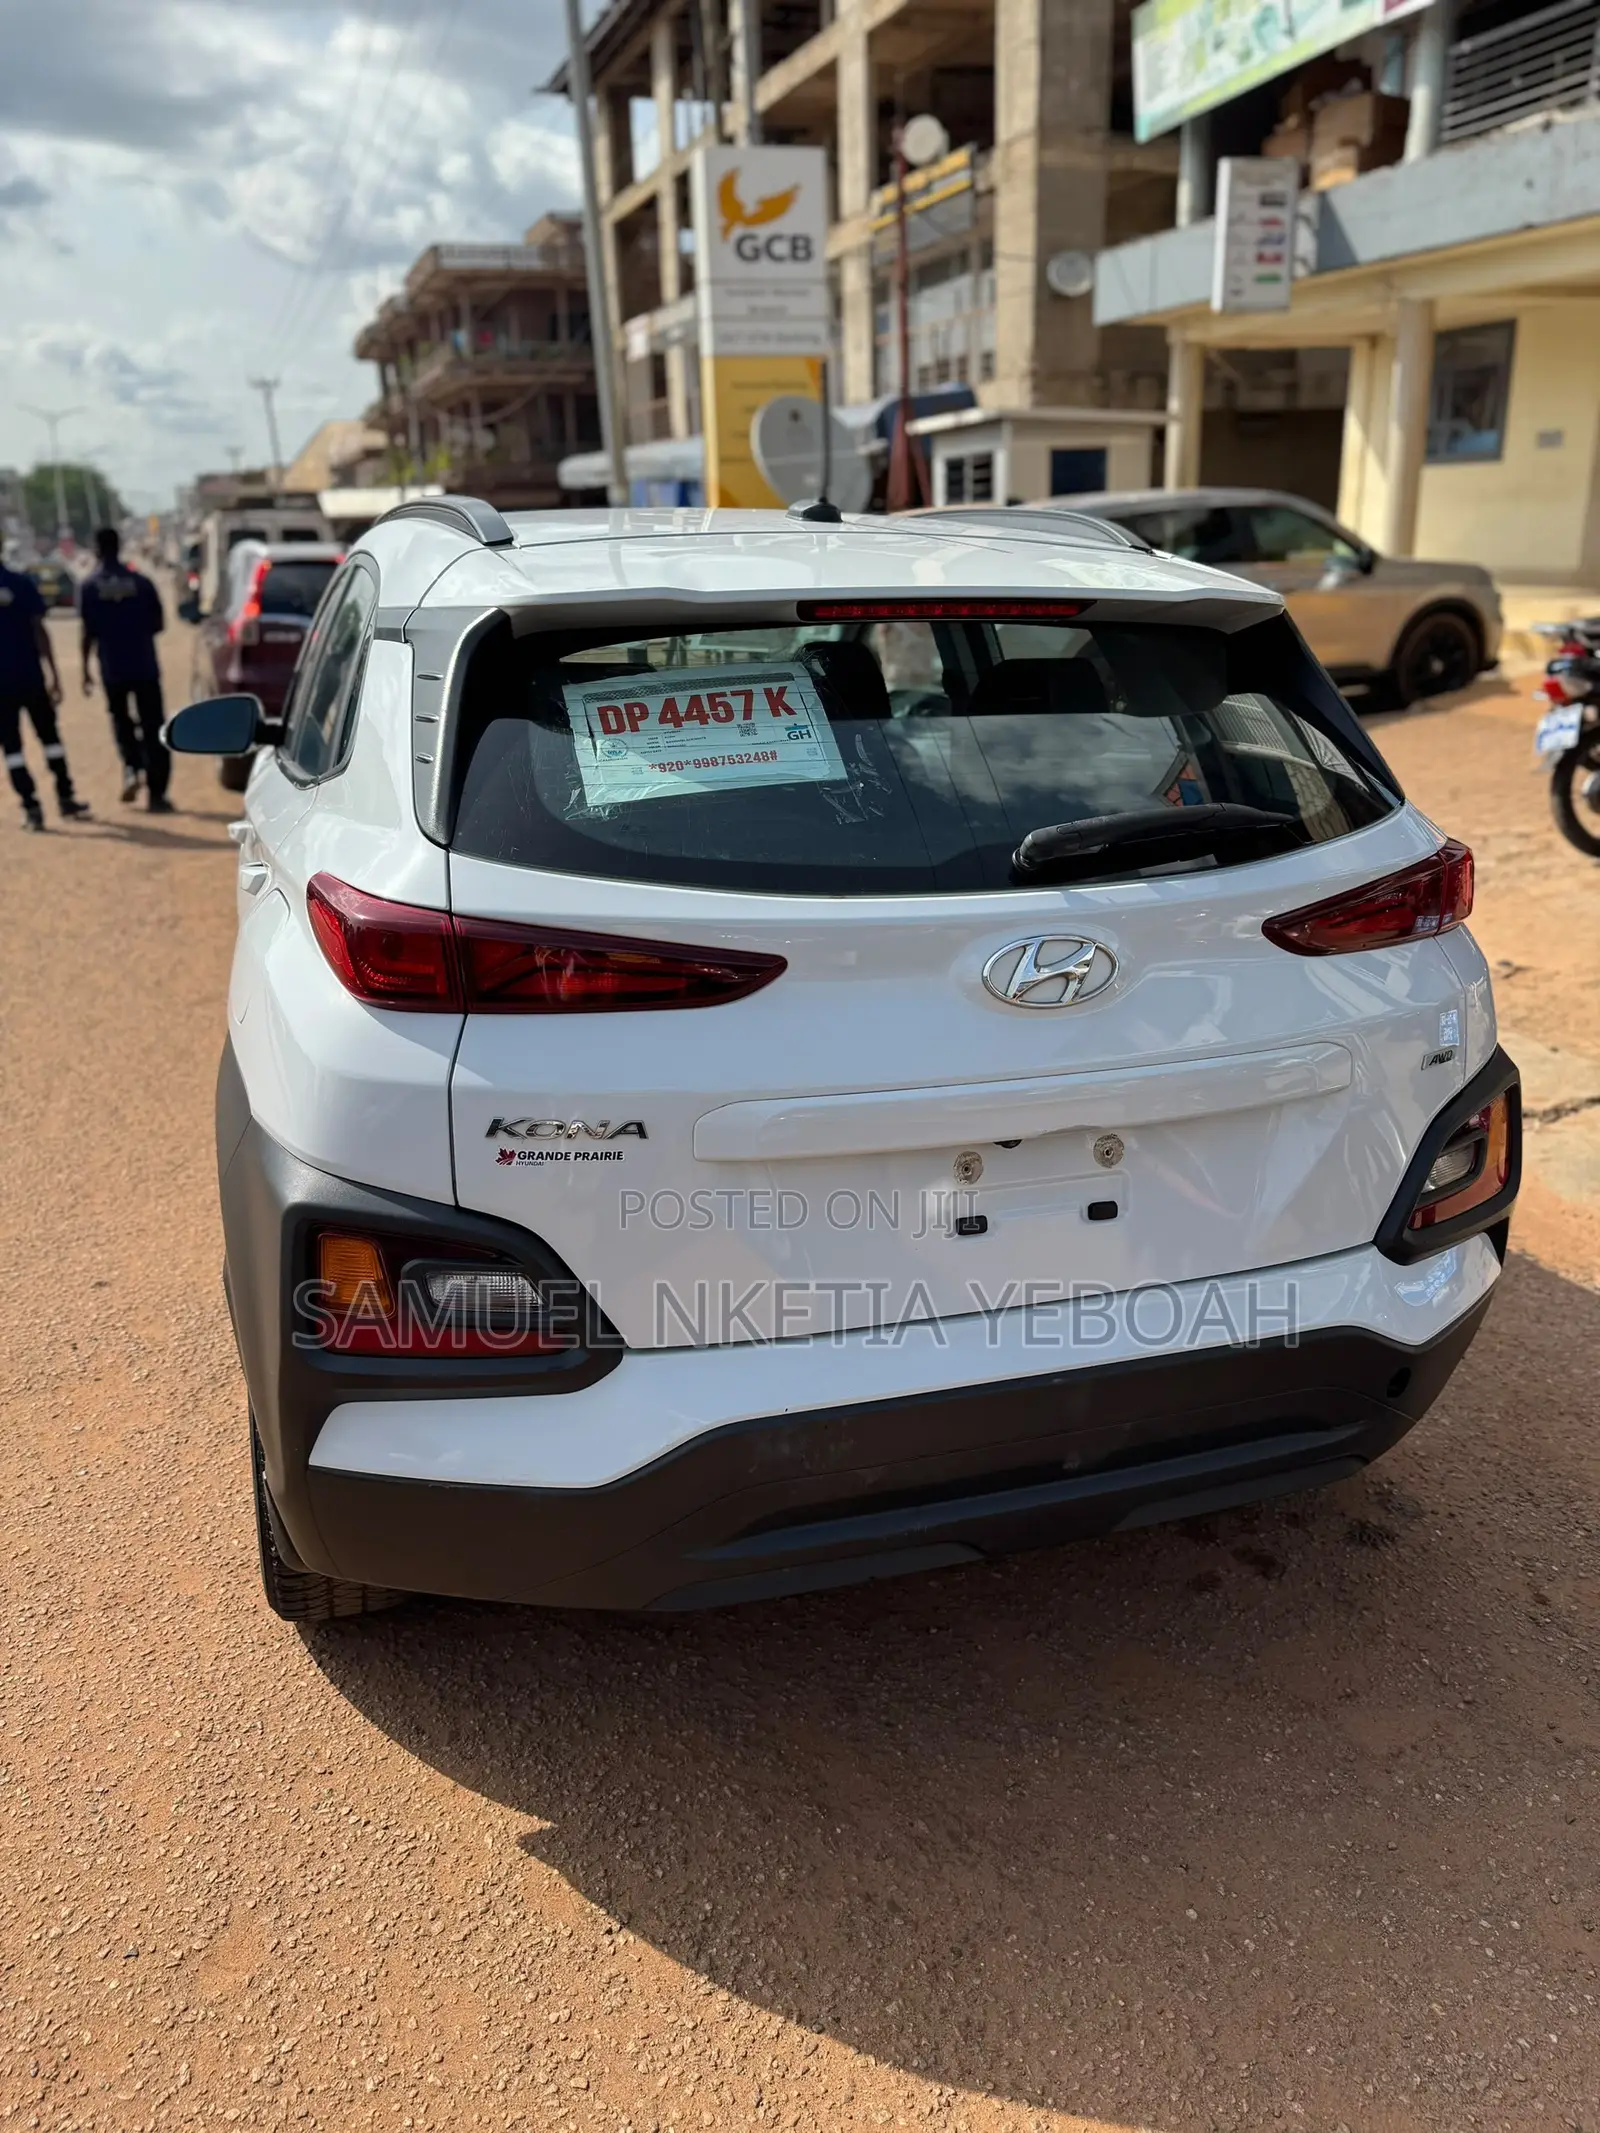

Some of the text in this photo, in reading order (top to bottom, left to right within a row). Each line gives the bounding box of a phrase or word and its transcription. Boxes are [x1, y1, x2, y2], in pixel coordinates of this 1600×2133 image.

[736, 232, 812, 262] GCB
[596, 686, 797, 735] DP 4457 K
[786, 729, 812, 741] GH
[1428, 1049, 1454, 1066] AWD
[485, 1117, 649, 1141] KONA
[517, 1150, 624, 1161] GRANDE PRAIRIE
